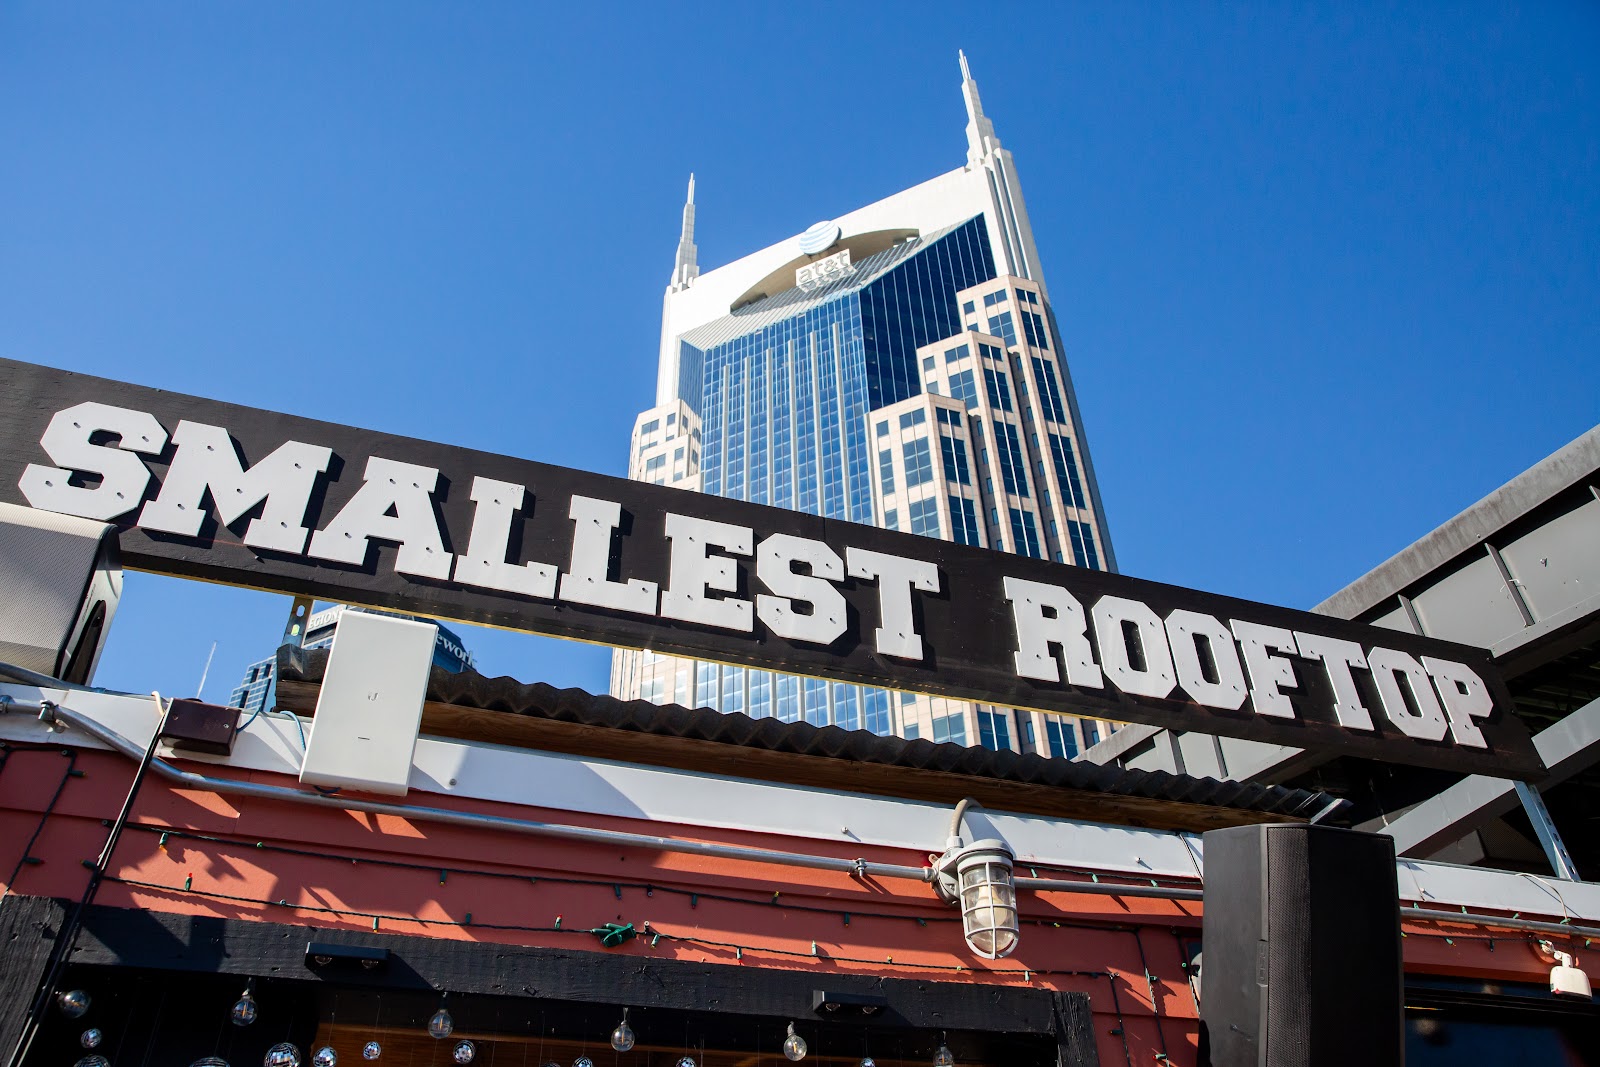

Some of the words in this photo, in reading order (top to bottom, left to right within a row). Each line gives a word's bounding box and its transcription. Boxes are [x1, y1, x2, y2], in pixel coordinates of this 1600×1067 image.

[799, 251, 850, 283] at&t
[18, 401, 941, 660] SMALLEST
[1003, 576, 1494, 748] ROOFTOP
[309, 609, 343, 629] EGION
